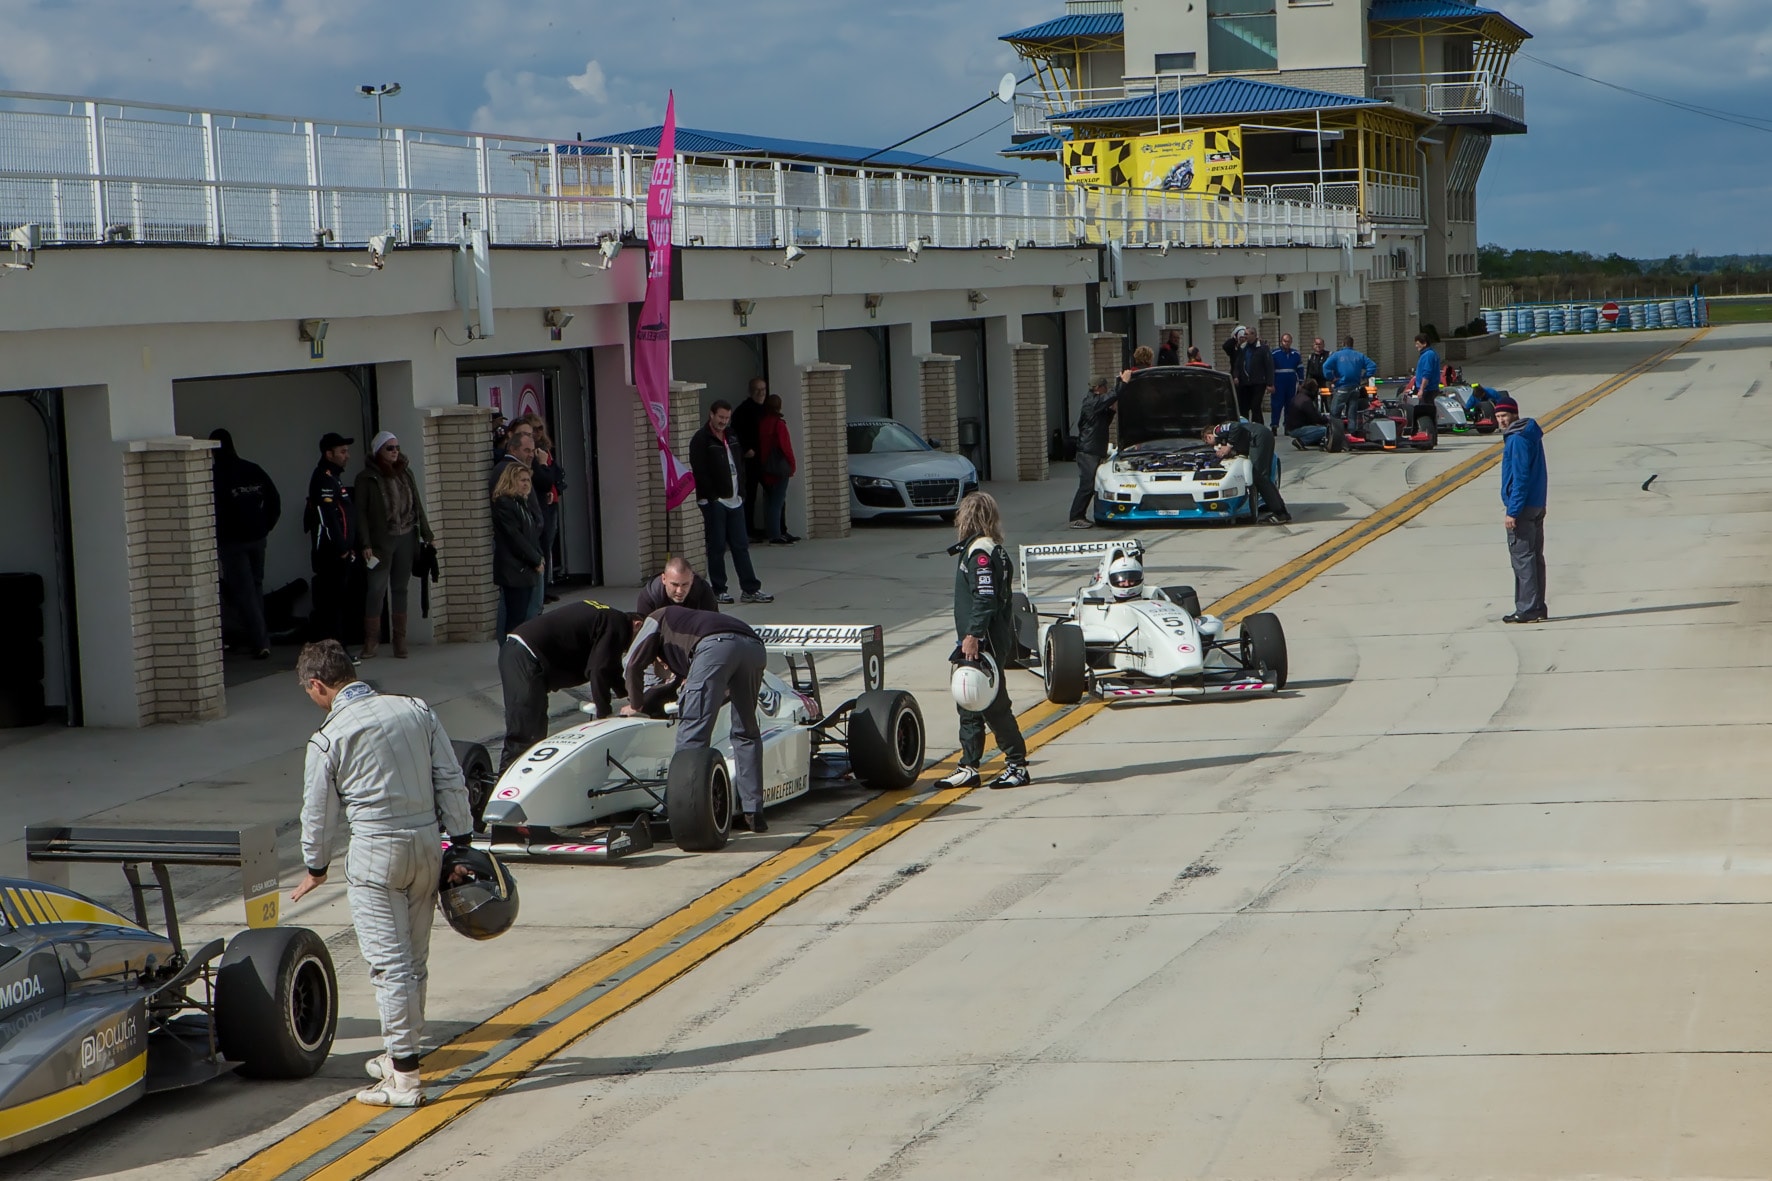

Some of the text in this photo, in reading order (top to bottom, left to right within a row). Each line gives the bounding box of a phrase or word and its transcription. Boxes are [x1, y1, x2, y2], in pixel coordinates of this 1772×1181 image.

[1211, 163, 1238, 172] DUNLOP
[1162, 616, 1184, 627] 5
[754, 627, 862, 644] ORMELFEELIN
[868, 654, 880, 690] 9
[528, 747, 560, 762] 9
[251, 882, 263, 893] CASA
[262, 901, 276, 922] 23
